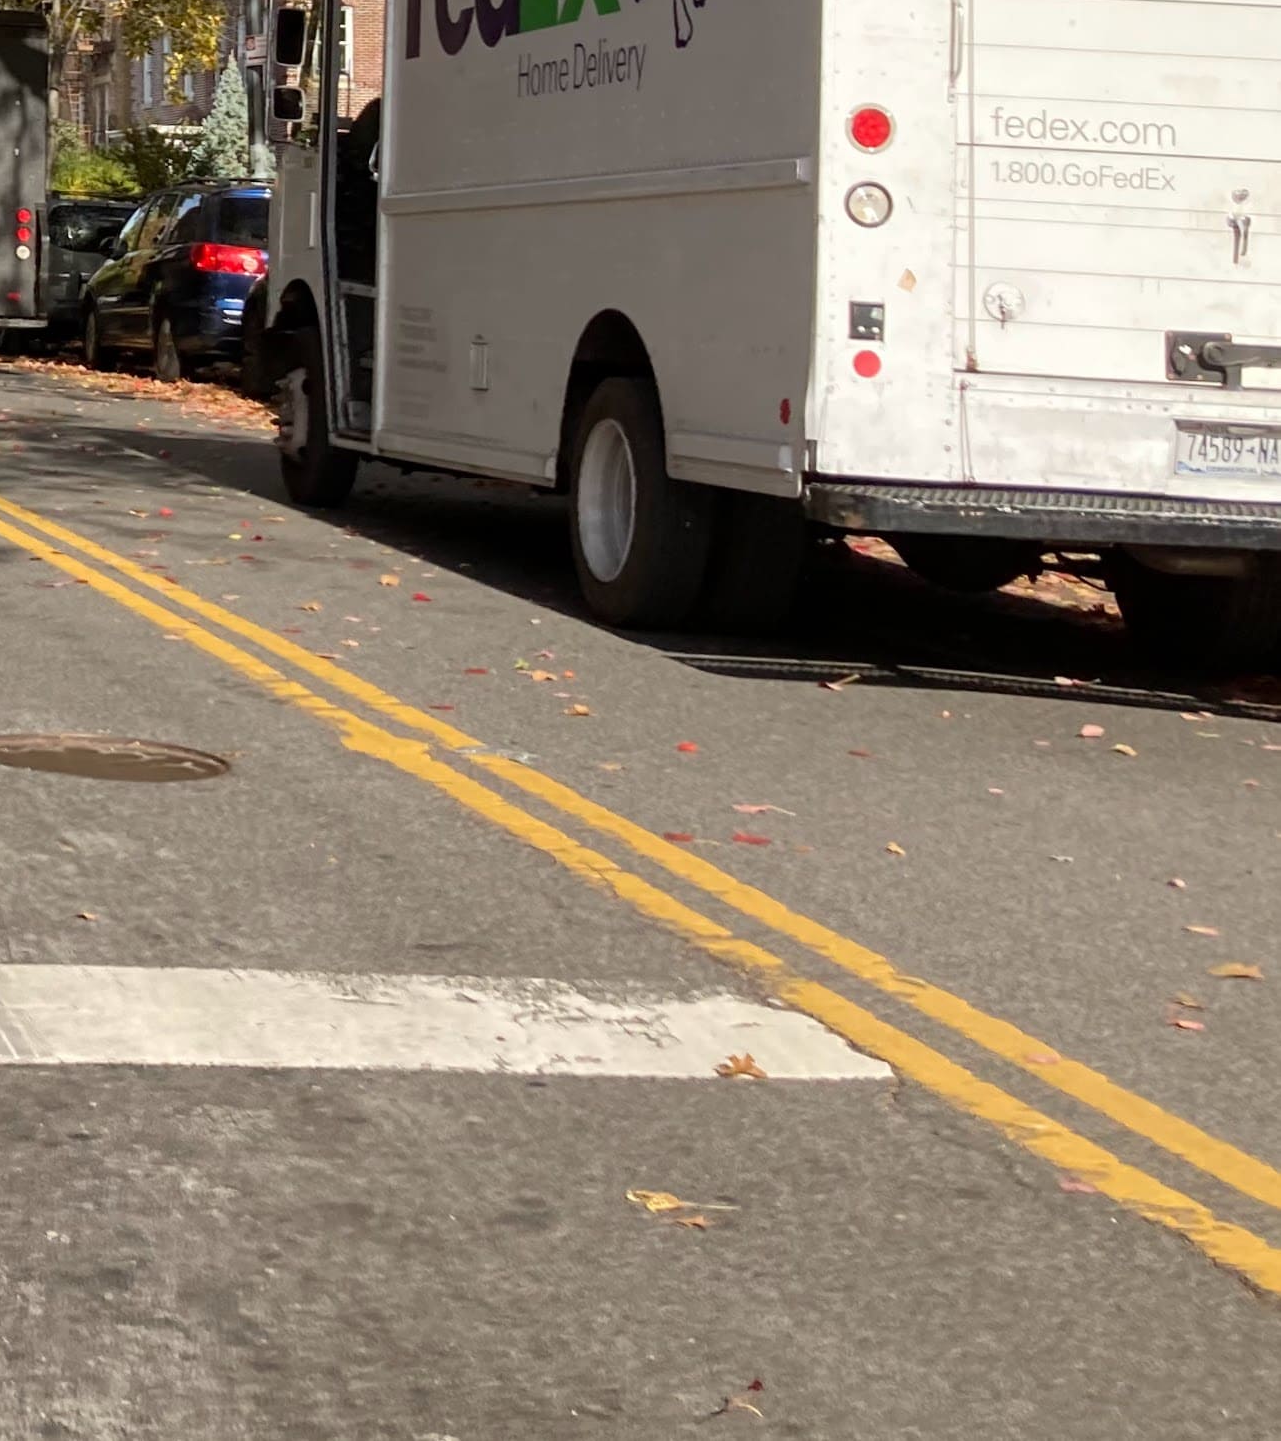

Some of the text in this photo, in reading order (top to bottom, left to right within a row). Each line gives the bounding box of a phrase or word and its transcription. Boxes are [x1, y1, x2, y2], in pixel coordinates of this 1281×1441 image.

[517, 37, 647, 98] Home Delivery
[990, 107, 1177, 147] fedex.com
[991, 161, 1177, 192] 1.800.GoFedEx
